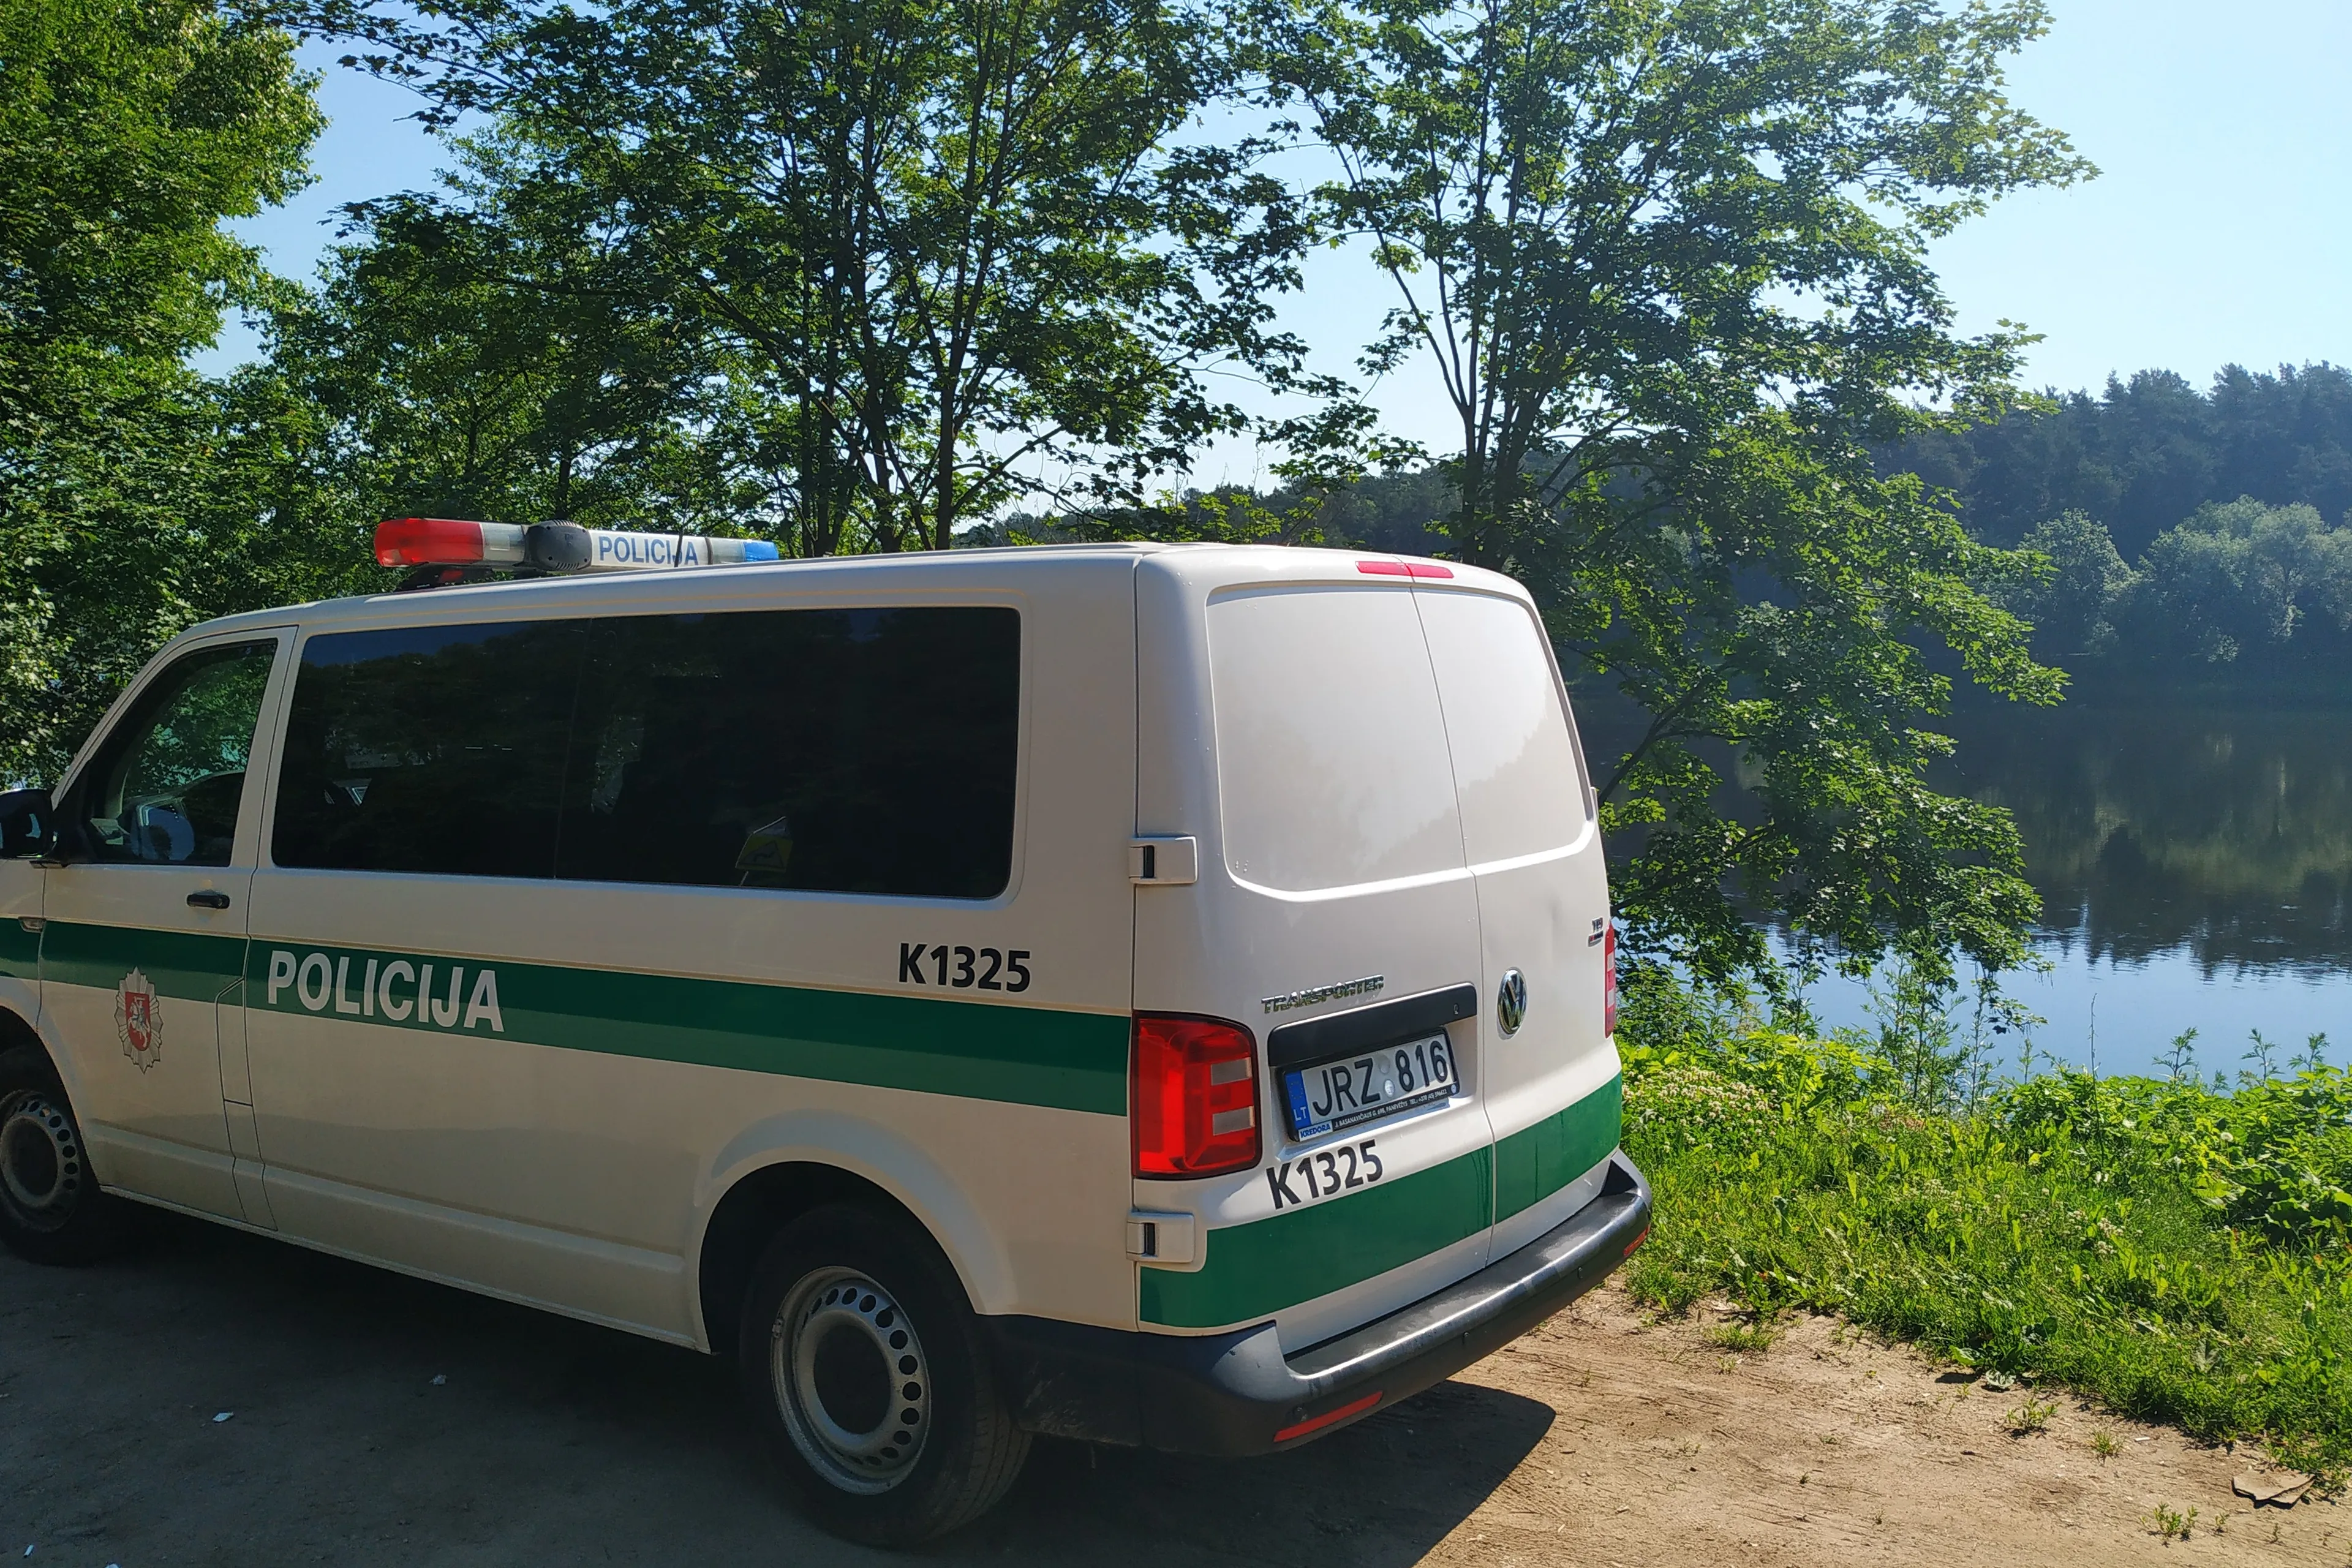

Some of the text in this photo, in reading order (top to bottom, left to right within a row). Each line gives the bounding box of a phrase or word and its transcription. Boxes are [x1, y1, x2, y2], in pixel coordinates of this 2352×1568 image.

[268, 949, 505, 1033] POLICIJA
[899, 942, 1031, 993] K1325
[1261, 974, 1384, 1014] TRANSPORTER
[1312, 1040, 1449, 1117] JRZ 816
[1293, 1106, 1306, 1121] LT
[1300, 1123, 1331, 1138] KREDORA
[1265, 1139, 1384, 1210] K1325
